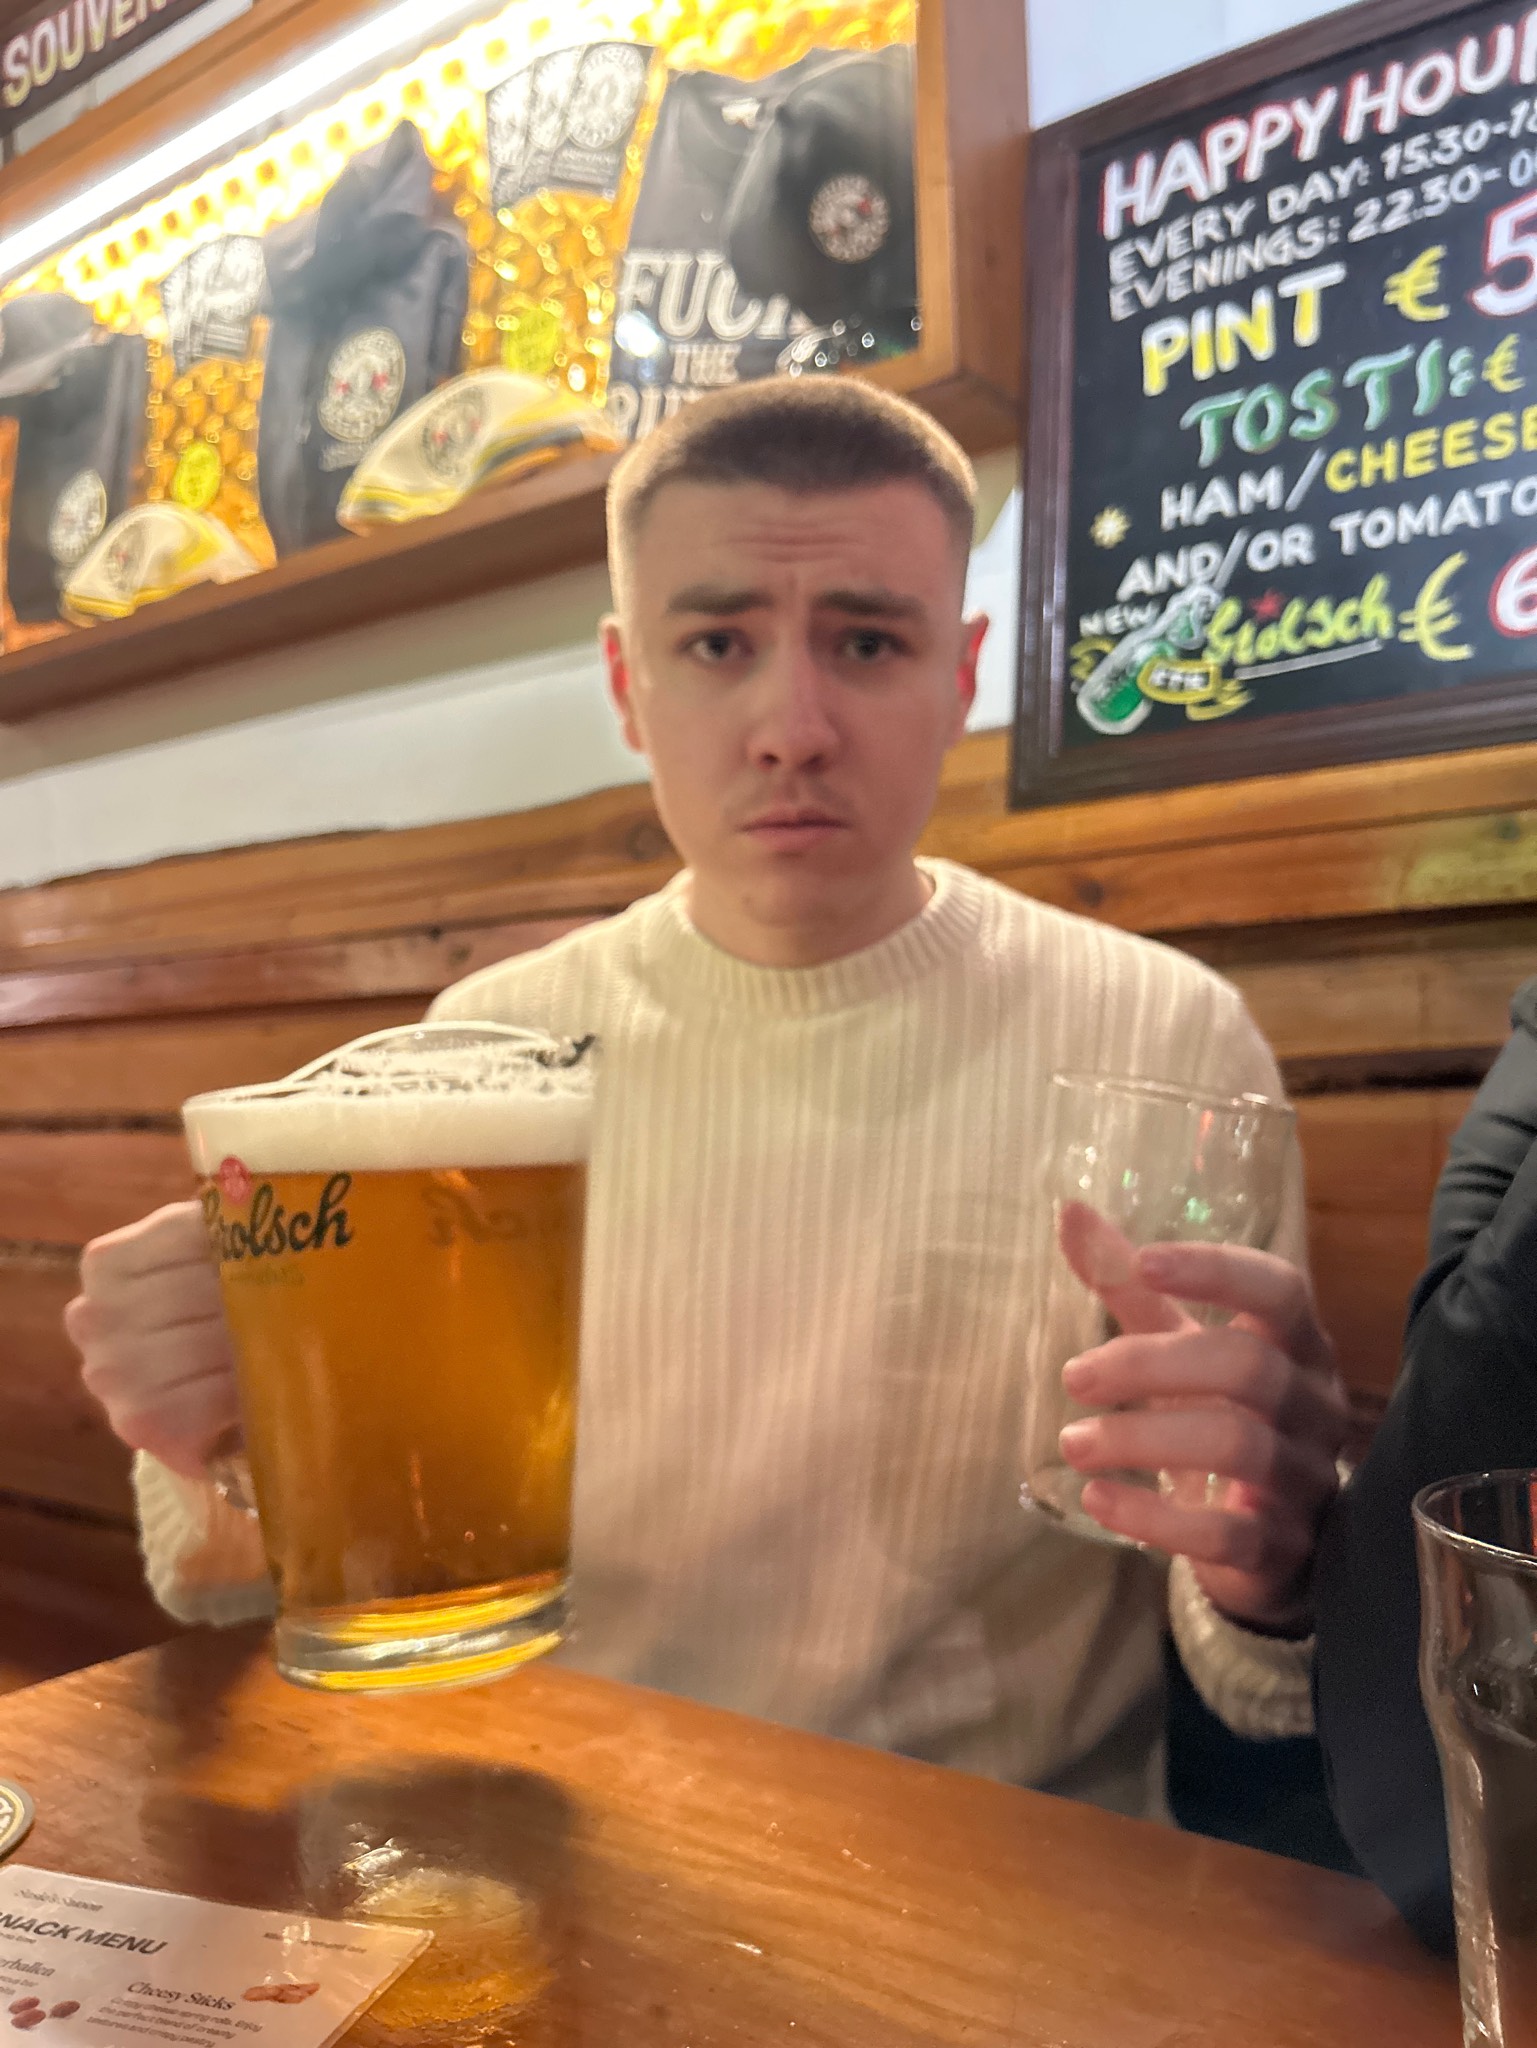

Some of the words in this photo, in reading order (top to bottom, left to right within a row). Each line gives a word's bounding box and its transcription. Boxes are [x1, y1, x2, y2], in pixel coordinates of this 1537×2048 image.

[2, 0, 168, 107] SOUVE
[1100, 85, 1338, 241] HAPPY
[1109, 198, 1257, 285] EVERY
[1267, 156, 1371, 223] DAY:
[1109, 215, 1341, 322] EVENINGS:
[1141, 261, 1347, 396] PINT
[1384, 244, 1450, 322] €
[1470, 190, 1537, 318] 5
[1481, 332, 1526, 393] €
[1115, 522, 1316, 602] AND/OR
[1329, 475, 1537, 556] TOMATO
[1079, 600, 1161, 638] NEW
[1398, 550, 1476, 662] €
[0, 1911, 81, 1940] NACK
[75, 1928, 168, 1955] MENU
[127, 1981, 181, 2003] Cheesy
[185, 1991, 236, 2011] Sticks
